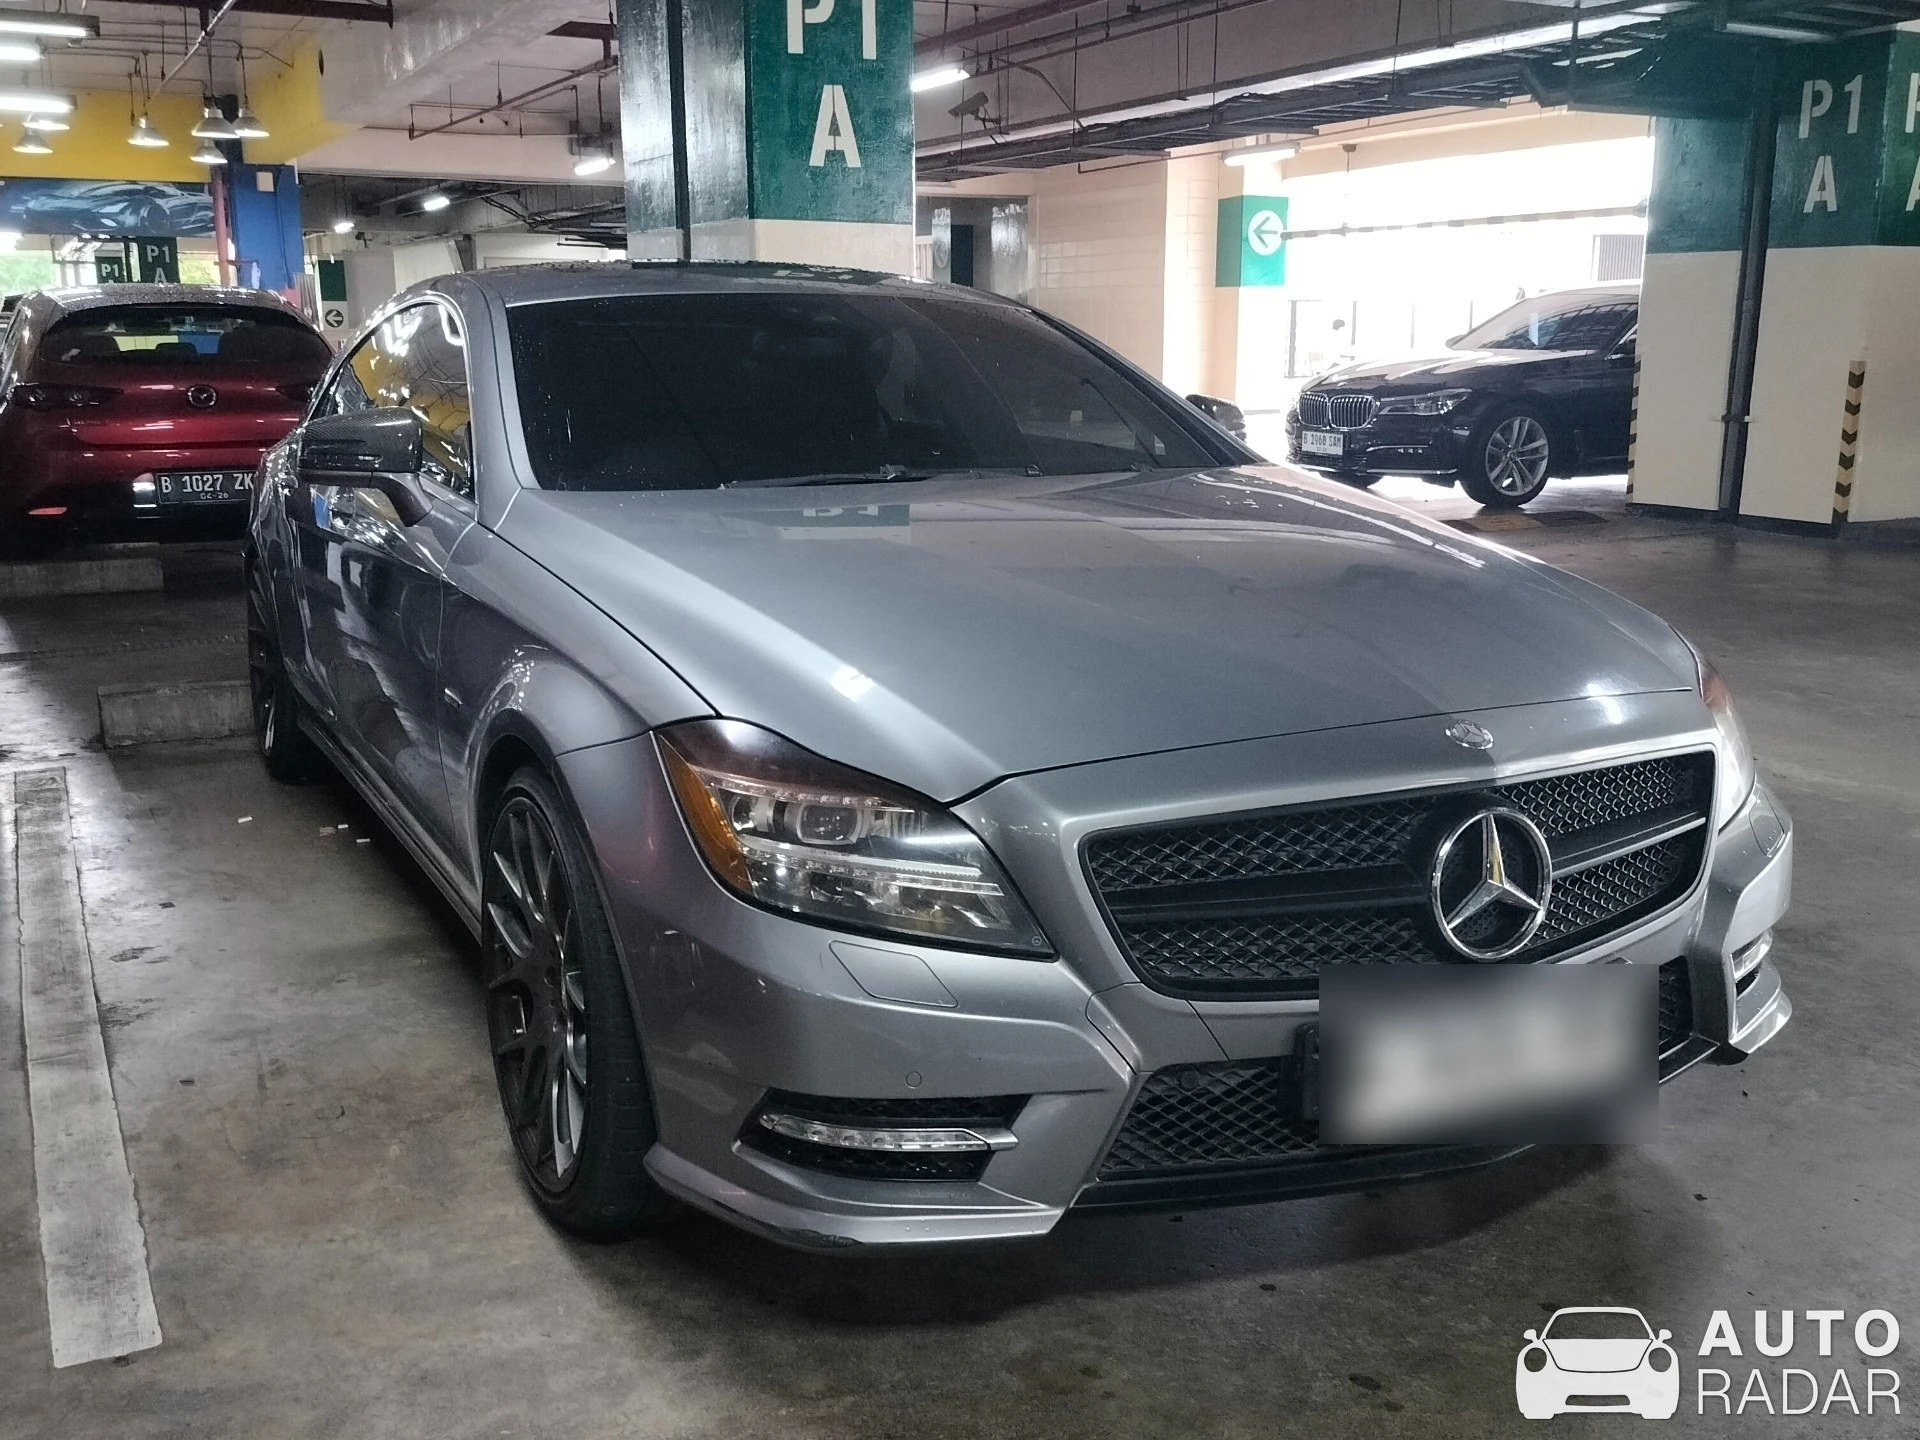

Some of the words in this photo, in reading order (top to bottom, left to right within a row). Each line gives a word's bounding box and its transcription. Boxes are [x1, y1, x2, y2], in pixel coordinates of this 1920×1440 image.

[1798, 74, 1863, 139] P1
[808, 84, 862, 168] A
[1803, 155, 1838, 213] A
[146, 244, 170, 263] P1
[101, 263, 119, 277] P1
[154, 267, 168, 285] A
[160, 476, 172, 493] B
[181, 474, 223, 493] 1027
